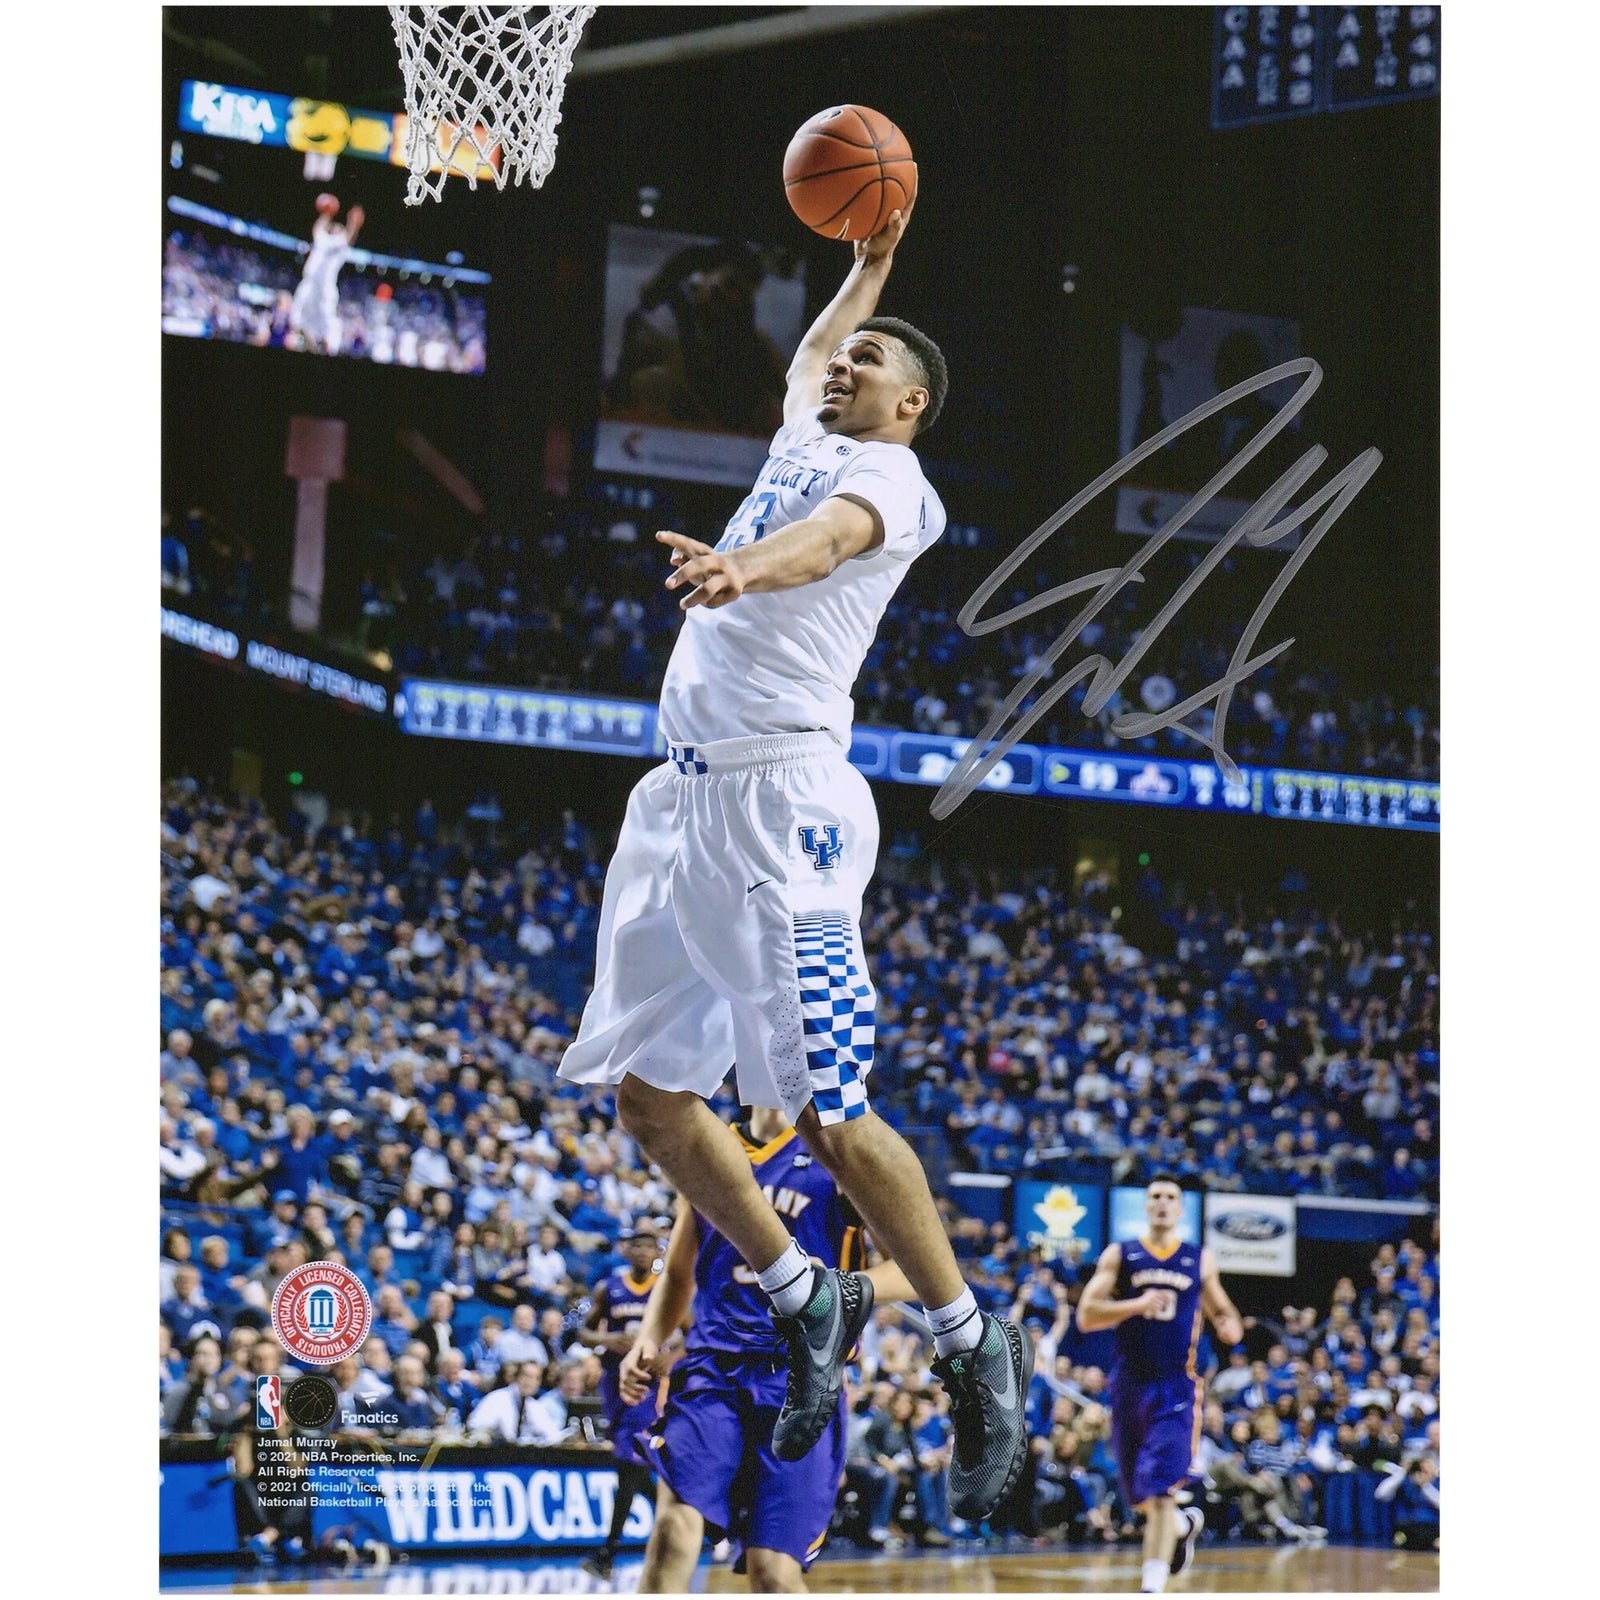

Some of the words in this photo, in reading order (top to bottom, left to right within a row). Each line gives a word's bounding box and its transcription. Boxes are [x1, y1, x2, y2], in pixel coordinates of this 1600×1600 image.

[246, 640, 310, 685] MOUNT
[308, 662, 388, 713] STERLING
[798, 824, 844, 871] UK
[377, 1468, 653, 1543] WILDCATS
